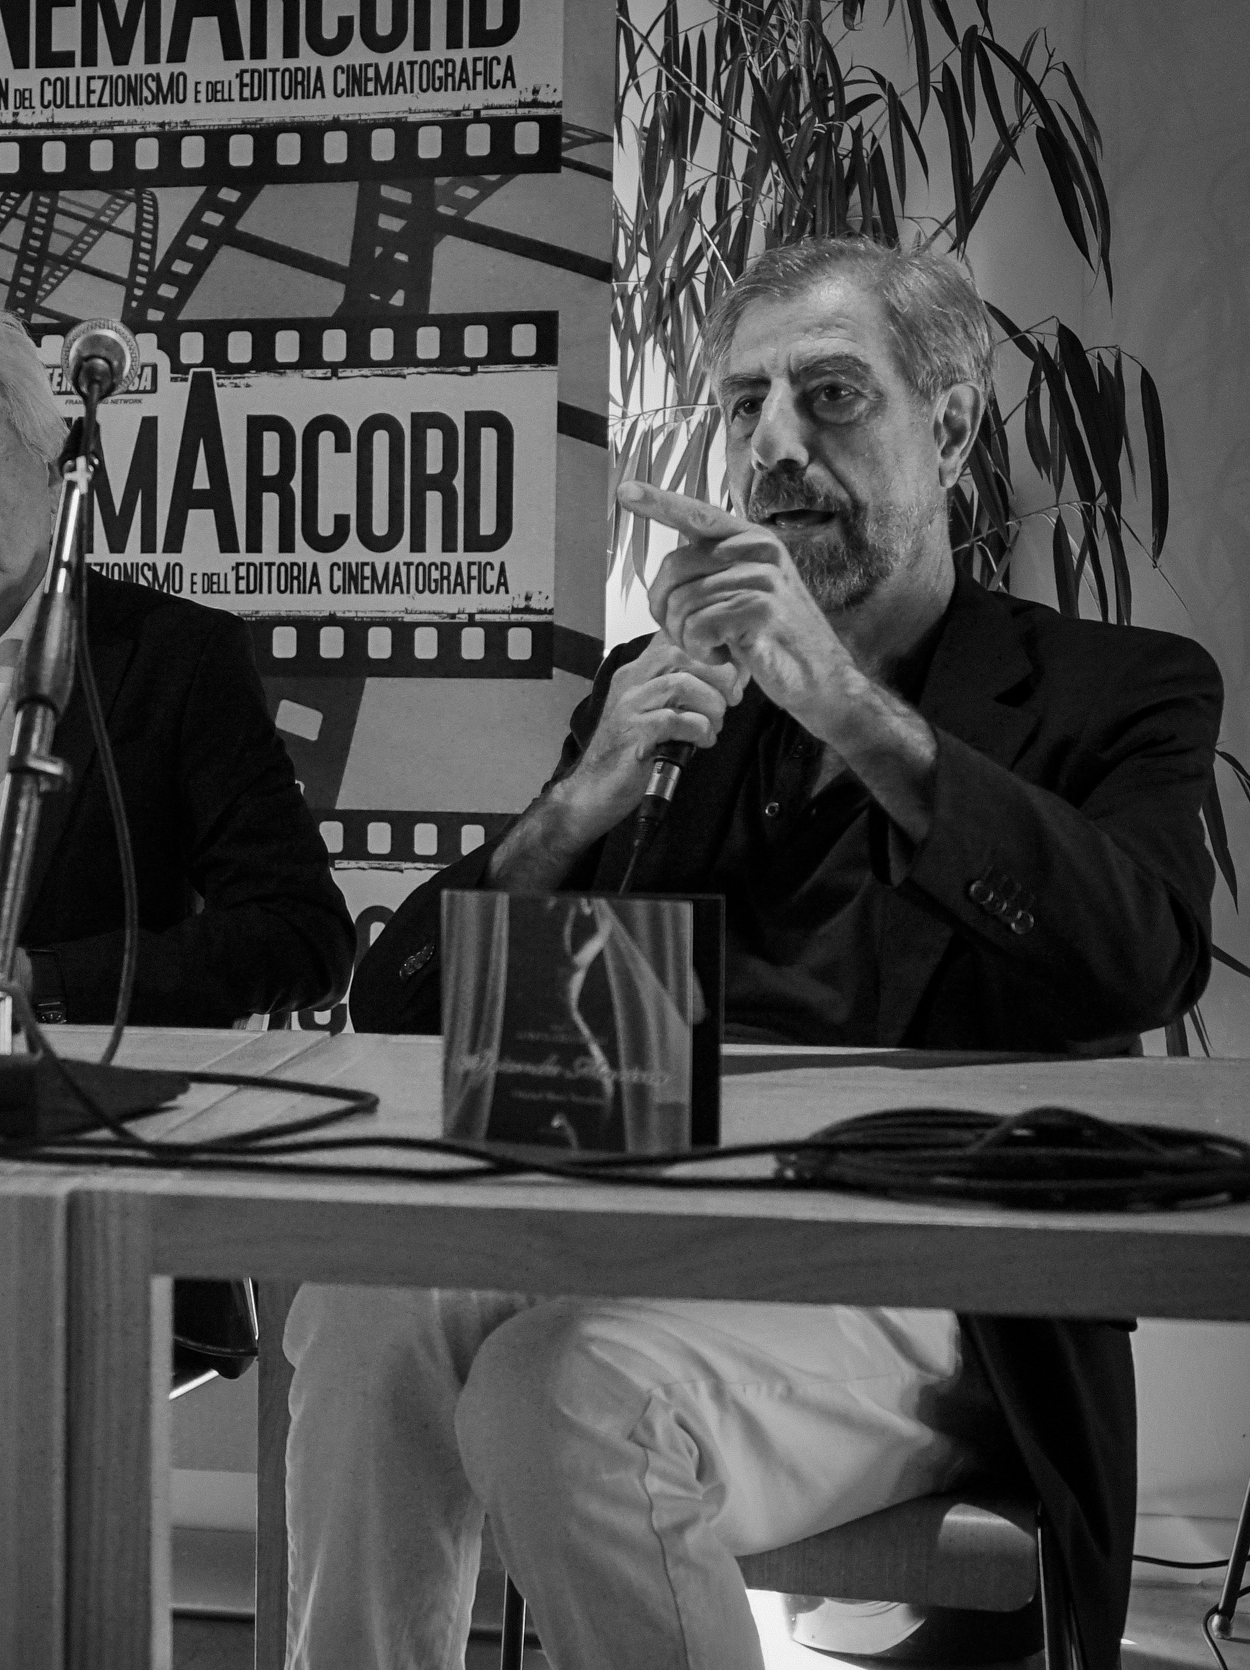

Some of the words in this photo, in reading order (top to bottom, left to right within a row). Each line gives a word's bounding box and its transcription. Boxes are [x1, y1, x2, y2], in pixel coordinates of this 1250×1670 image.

[13, 87, 36, 110] DEL
[39, 71, 188, 109] COLLEZIONISMO
[194, 81, 202, 103] E
[332, 54, 517, 98] CINEMATOGRAFICA
[190, 572, 198, 595] E
[329, 561, 509, 595] CINEMATOGRAFICA
